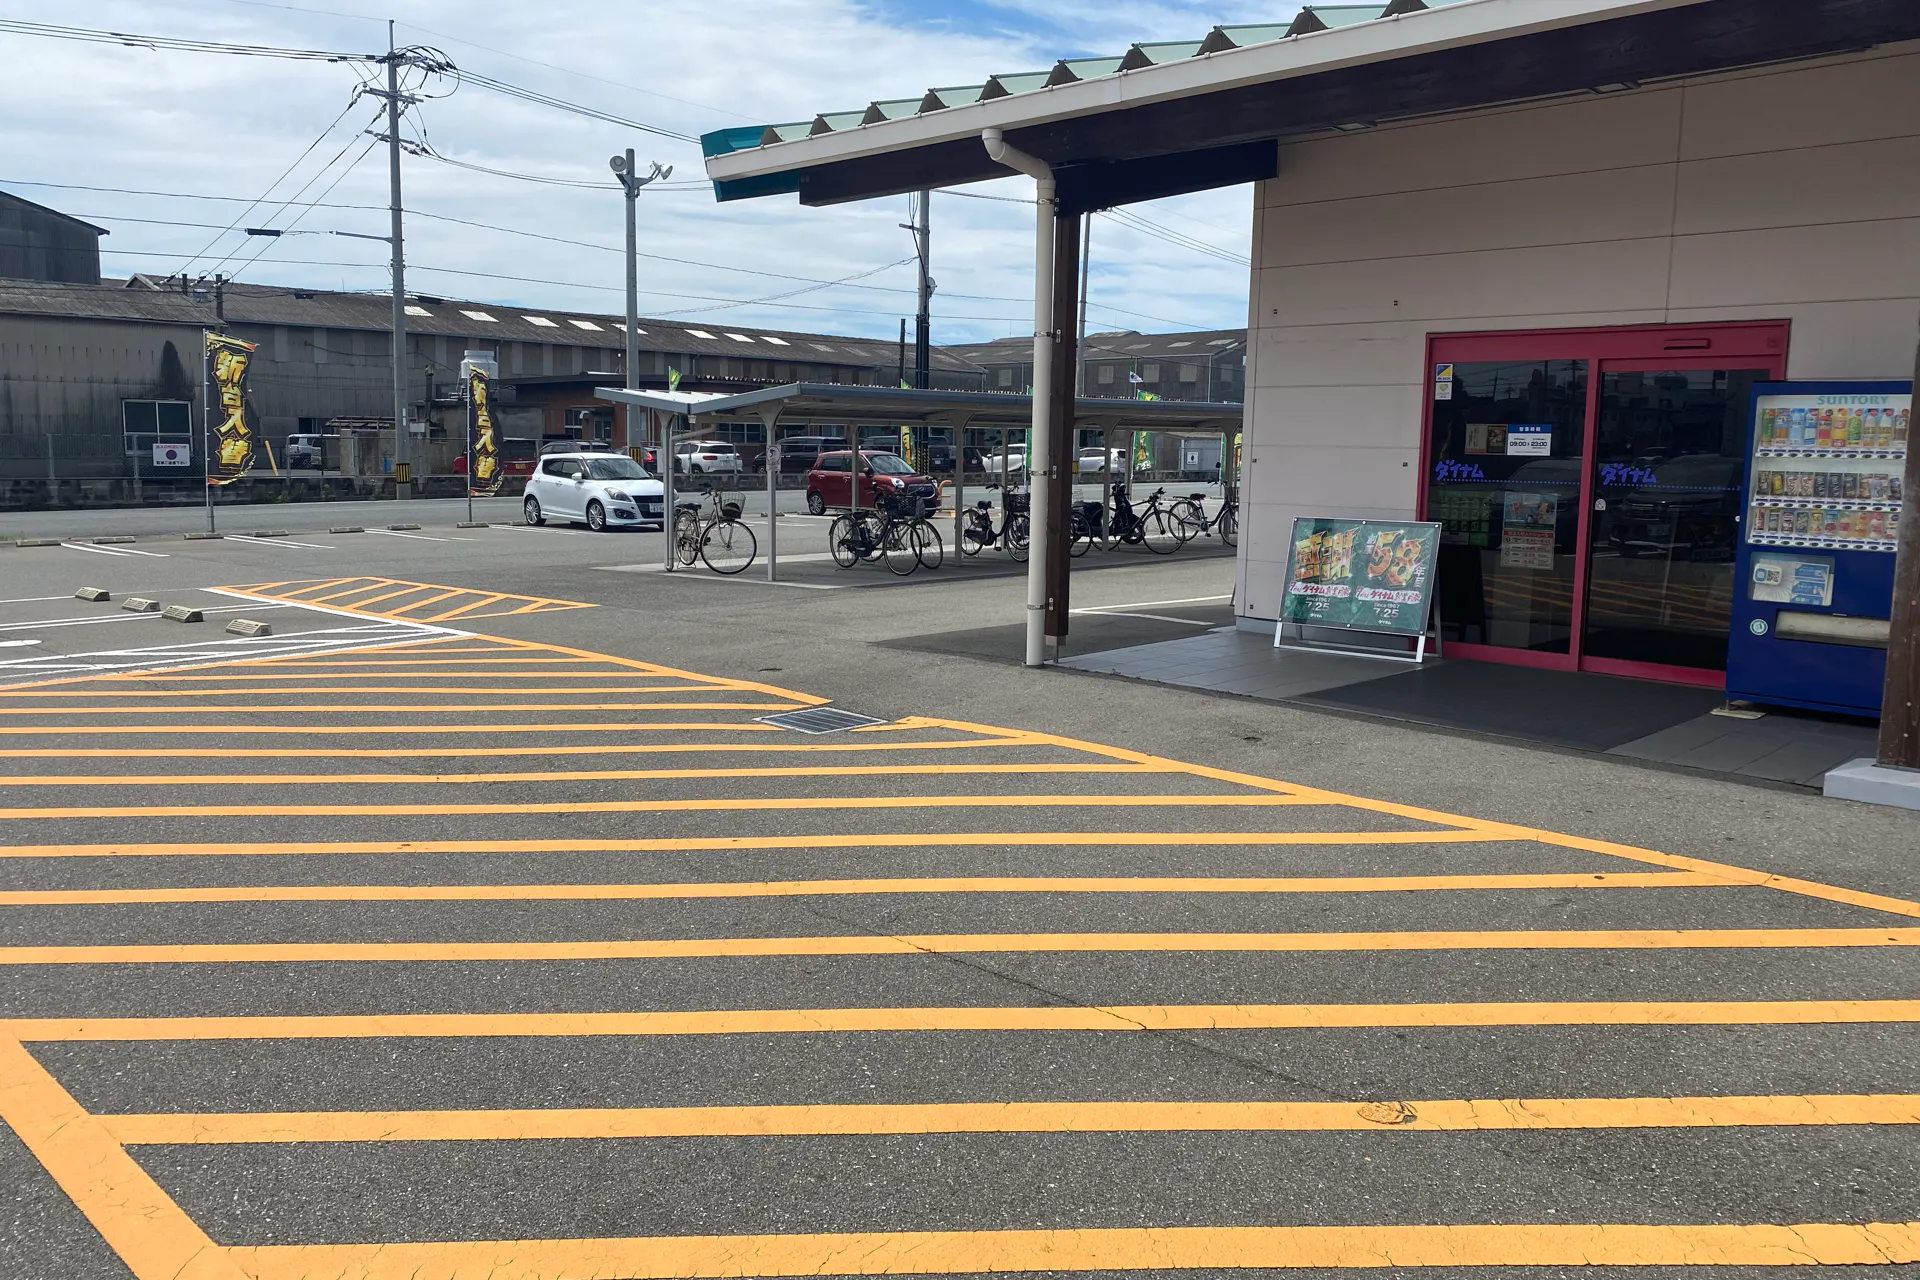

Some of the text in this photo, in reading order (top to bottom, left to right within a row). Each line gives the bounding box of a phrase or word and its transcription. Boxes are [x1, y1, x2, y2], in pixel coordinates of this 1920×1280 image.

[212, 350, 251, 466] 新台入替
[1435, 460, 1484, 480] ダイナム
[1601, 463, 1657, 485] ダイナム
[1294, 528, 1359, 581] 感謝
[1367, 530, 1425, 587] 58
[1306, 602, 1330, 611] 7.25
[1373, 608, 1399, 618] 7.25
